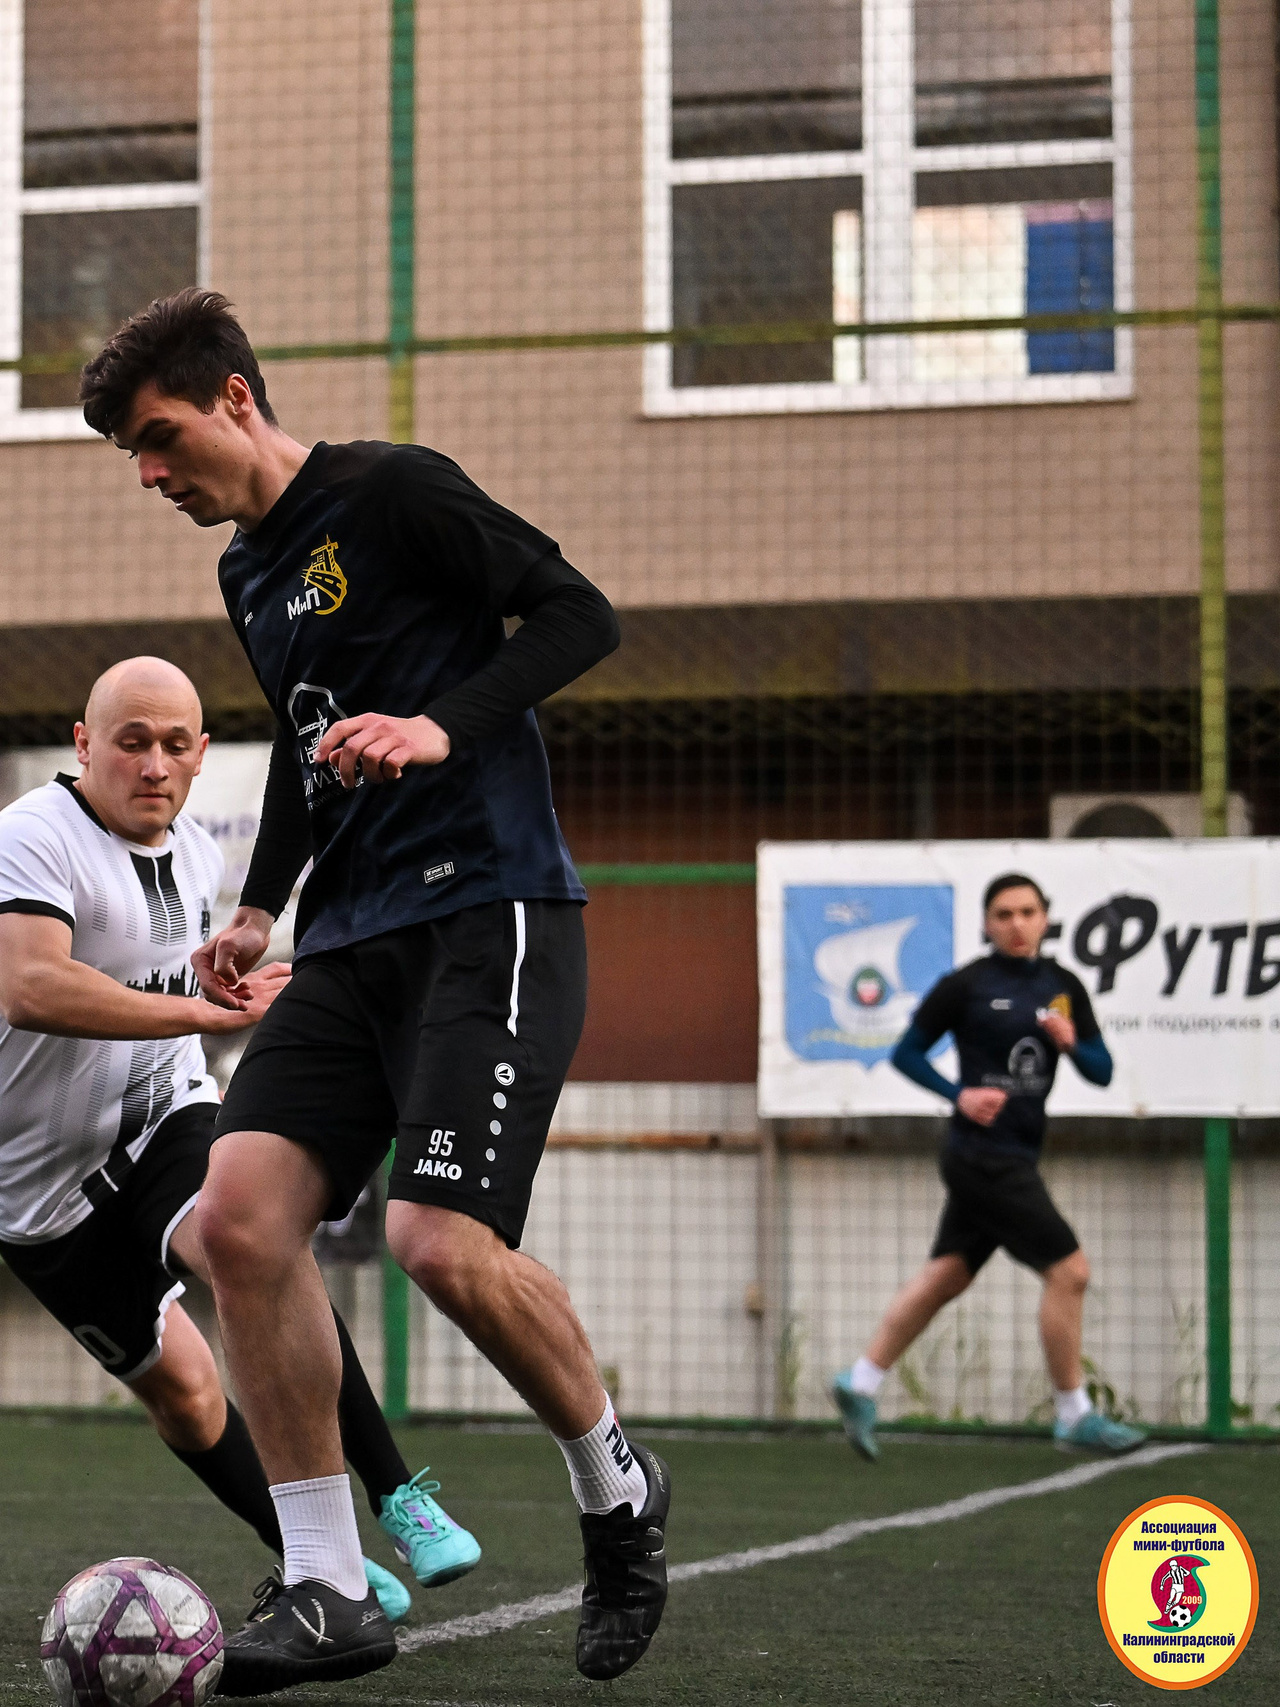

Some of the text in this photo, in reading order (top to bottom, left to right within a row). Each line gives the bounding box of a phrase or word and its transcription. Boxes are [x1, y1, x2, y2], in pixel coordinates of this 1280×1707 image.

[1045, 890, 1280, 997] ФУТБ
[428, 1129, 455, 1157] 95
[413, 1159, 462, 1180] JAKO
